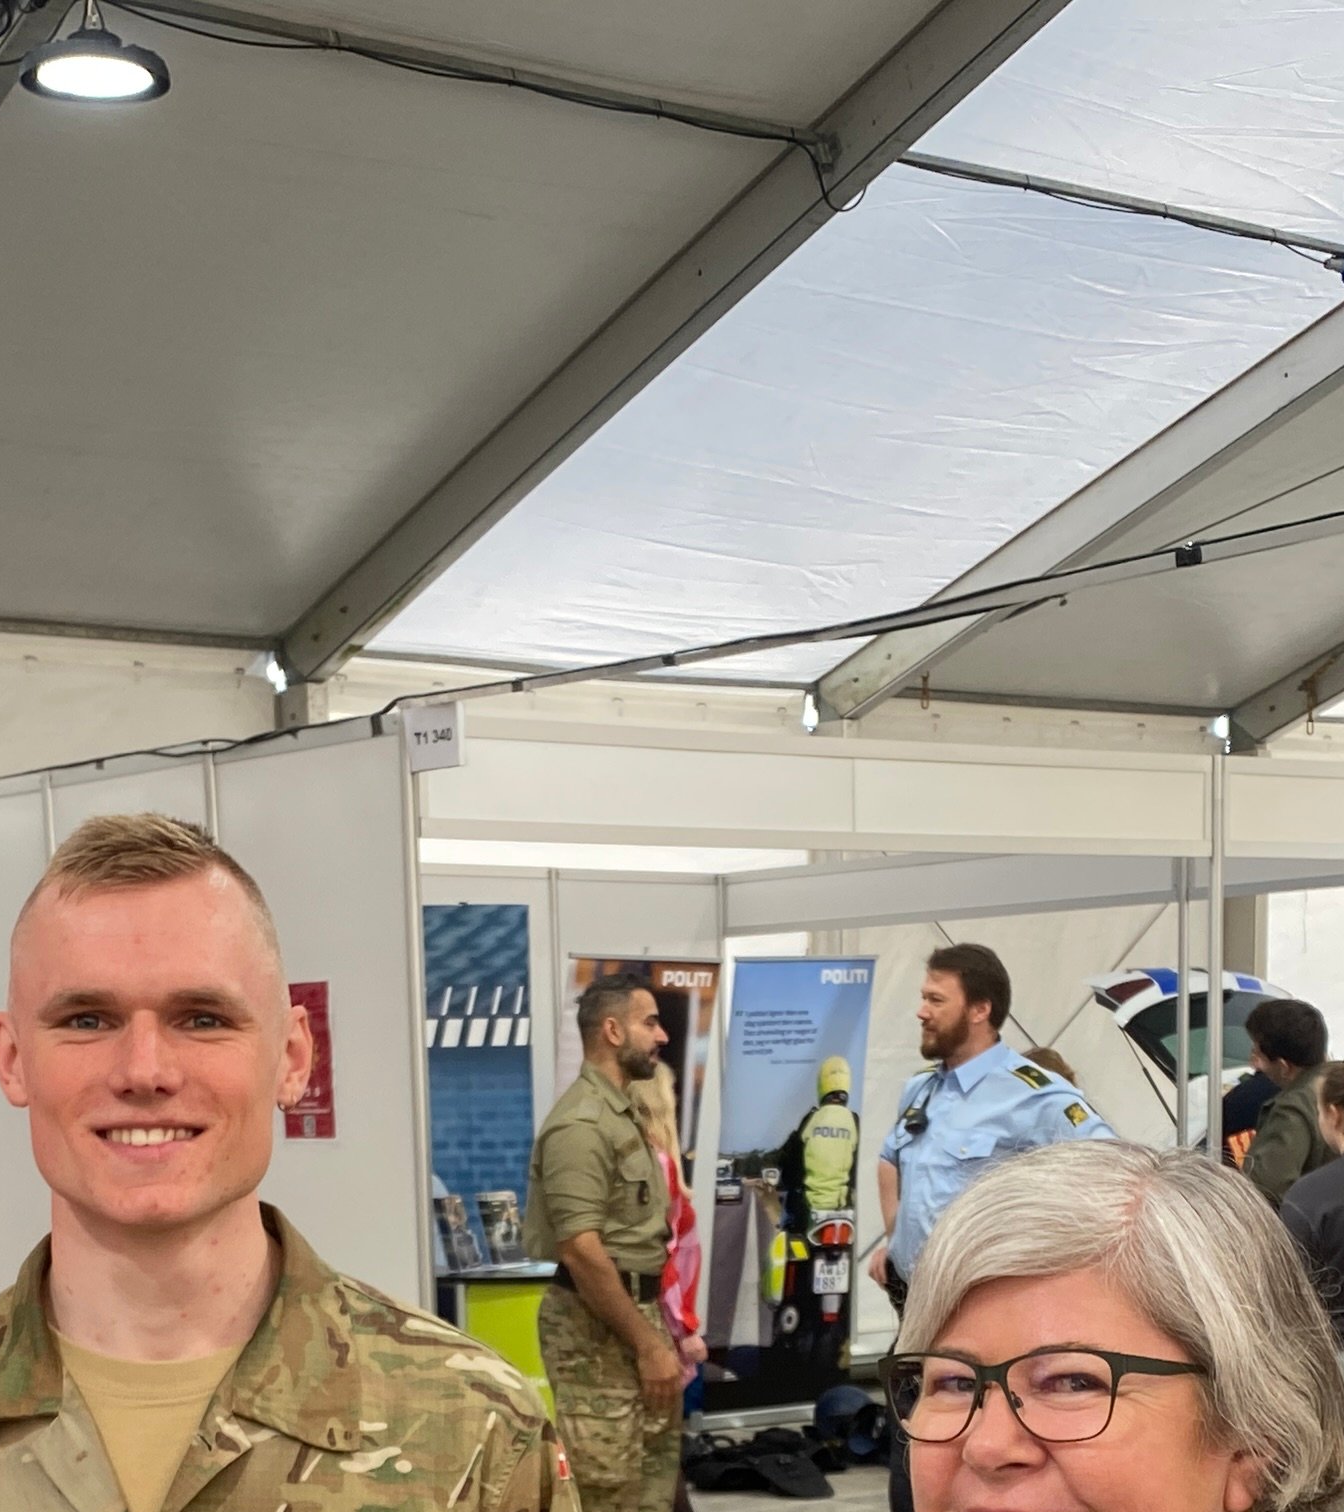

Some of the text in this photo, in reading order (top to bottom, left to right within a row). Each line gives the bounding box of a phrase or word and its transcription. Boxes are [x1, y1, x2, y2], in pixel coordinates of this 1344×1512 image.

[414, 727, 453, 745] T1 340
[662, 971, 713, 987] POLITI
[821, 969, 868, 984] POLITI
[813, 1126, 850, 1140] POLITI
